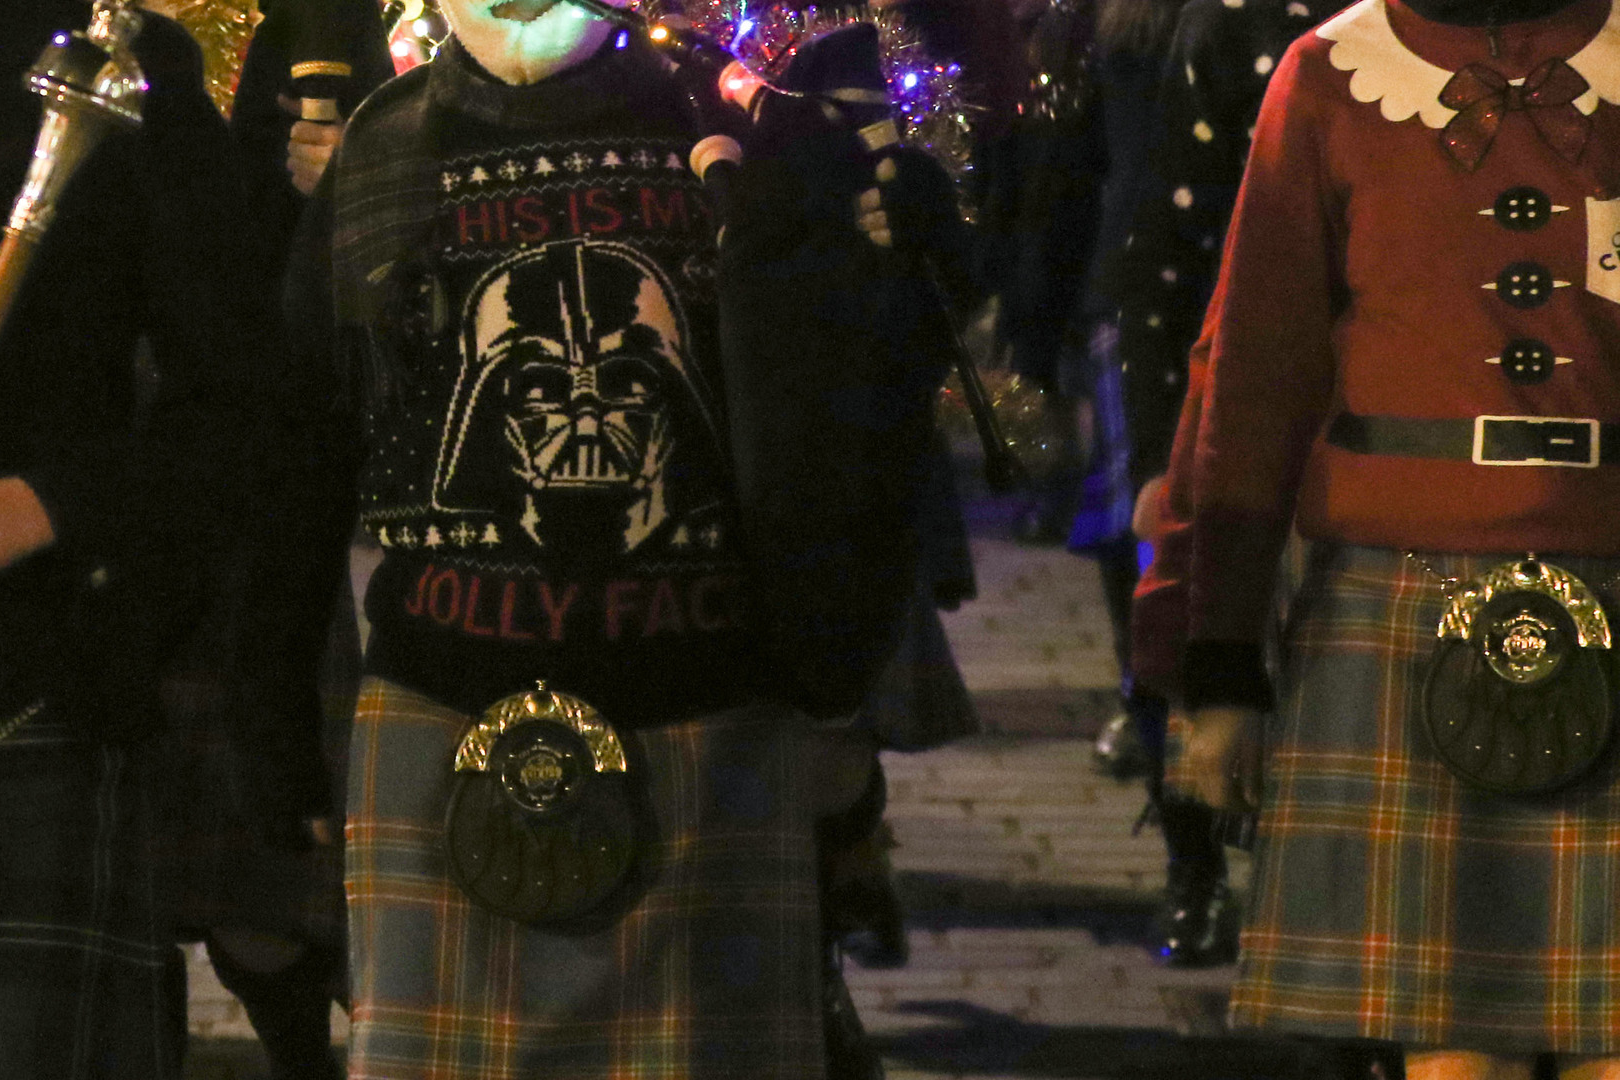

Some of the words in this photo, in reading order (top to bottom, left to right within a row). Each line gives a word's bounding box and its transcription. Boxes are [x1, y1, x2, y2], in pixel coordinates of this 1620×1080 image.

[457, 196, 549, 244] HIS
[568, 188, 622, 234] IS
[404, 564, 577, 641] JOLLY
[605, 575, 735, 638] FAC
